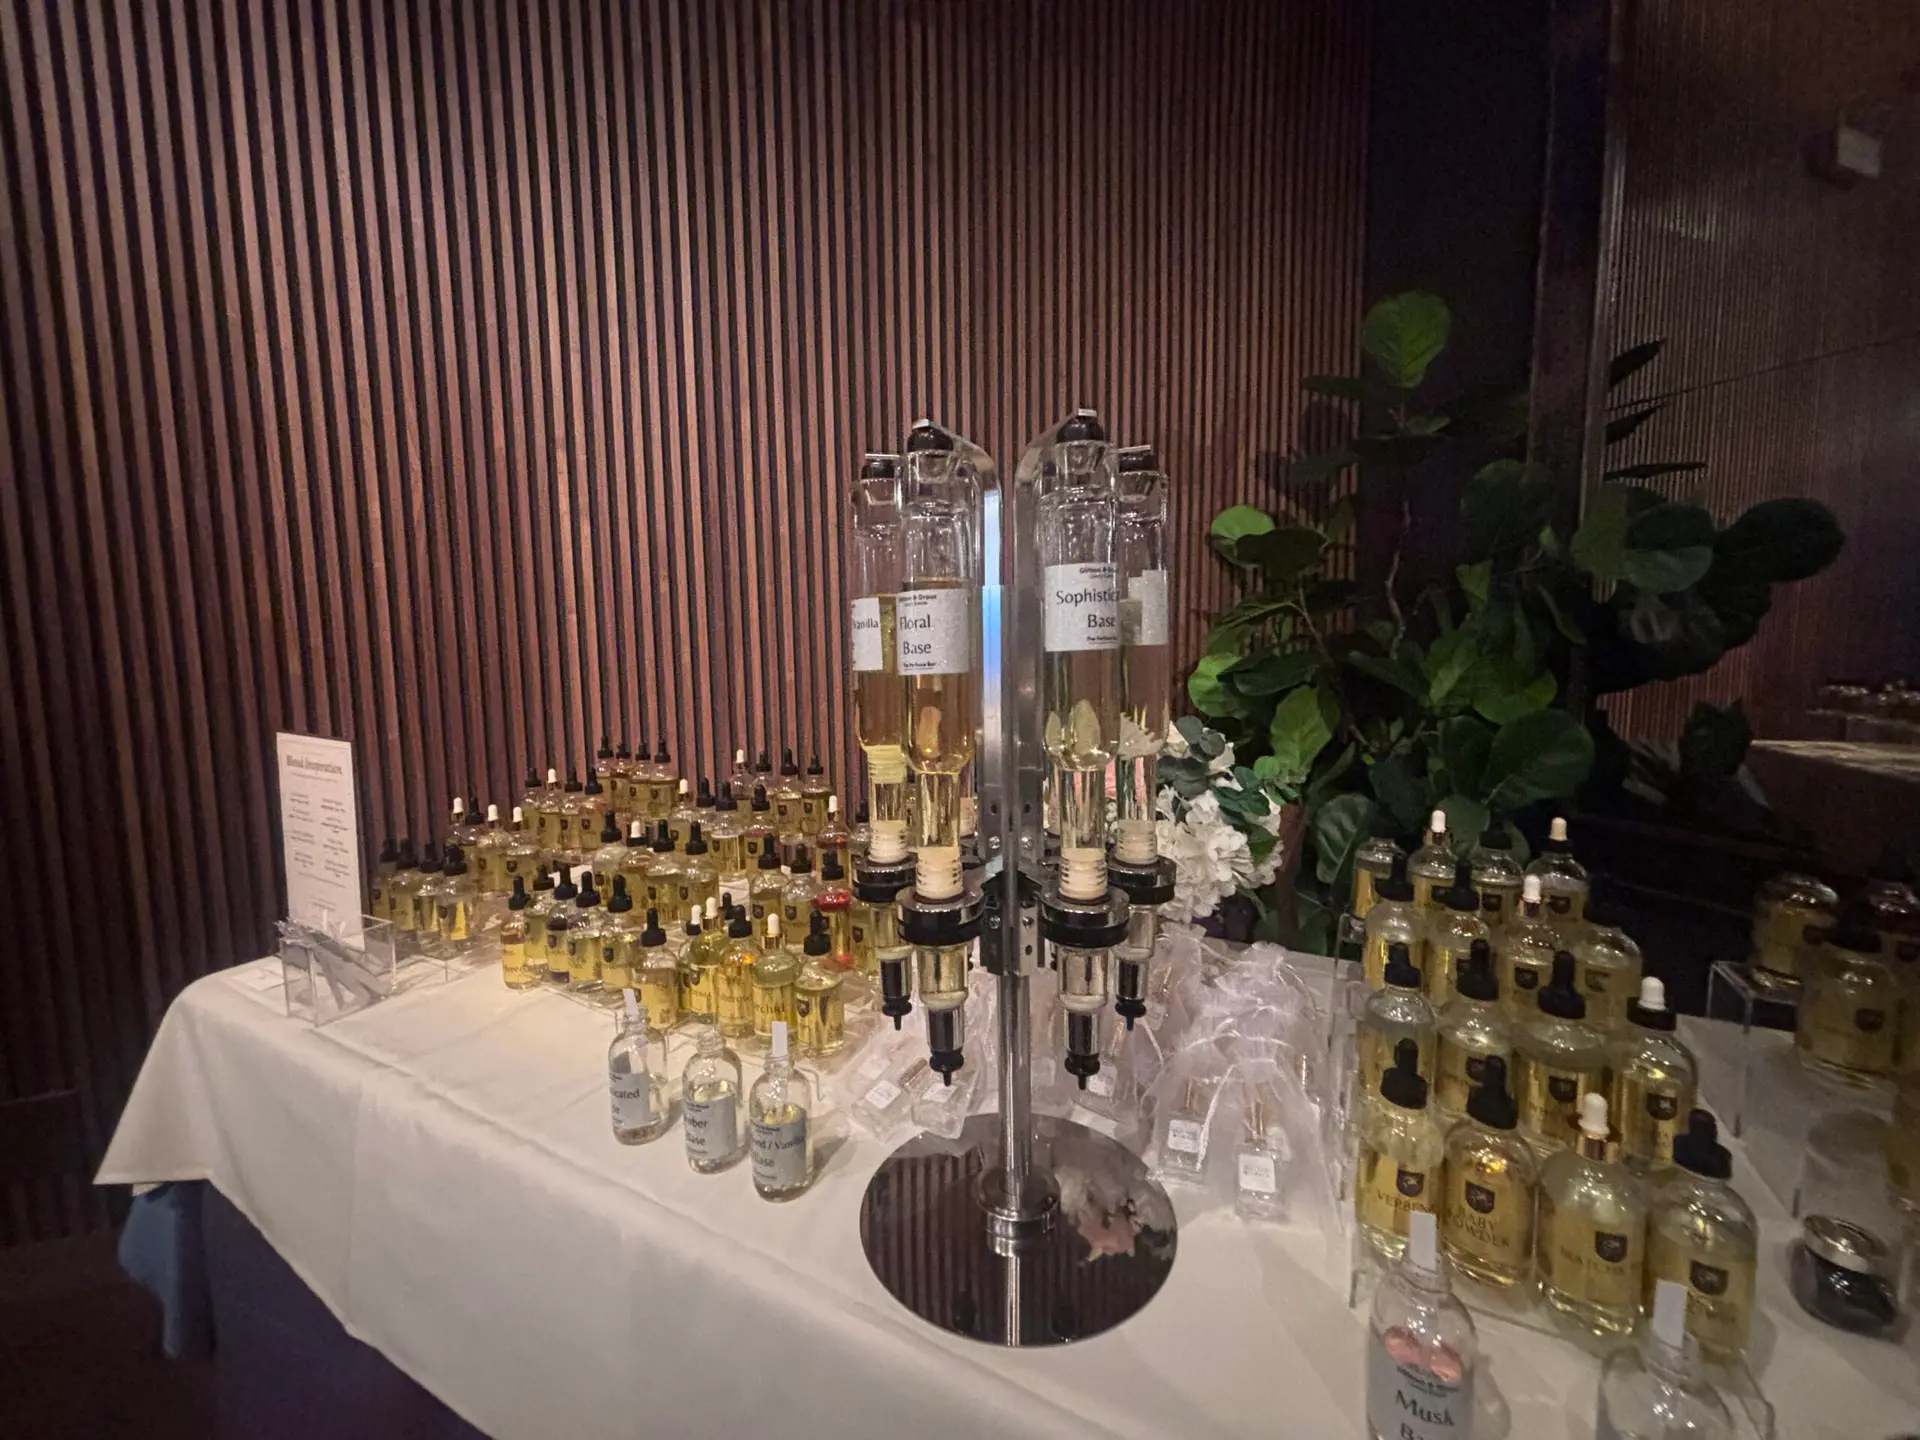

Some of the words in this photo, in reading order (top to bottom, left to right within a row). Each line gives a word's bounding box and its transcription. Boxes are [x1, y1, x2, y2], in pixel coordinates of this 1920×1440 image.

[899, 614, 931, 630] Floral
[1088, 613, 1117, 628] Base
[903, 641, 932, 655] Base
[1395, 1389, 1455, 1427] Musk
